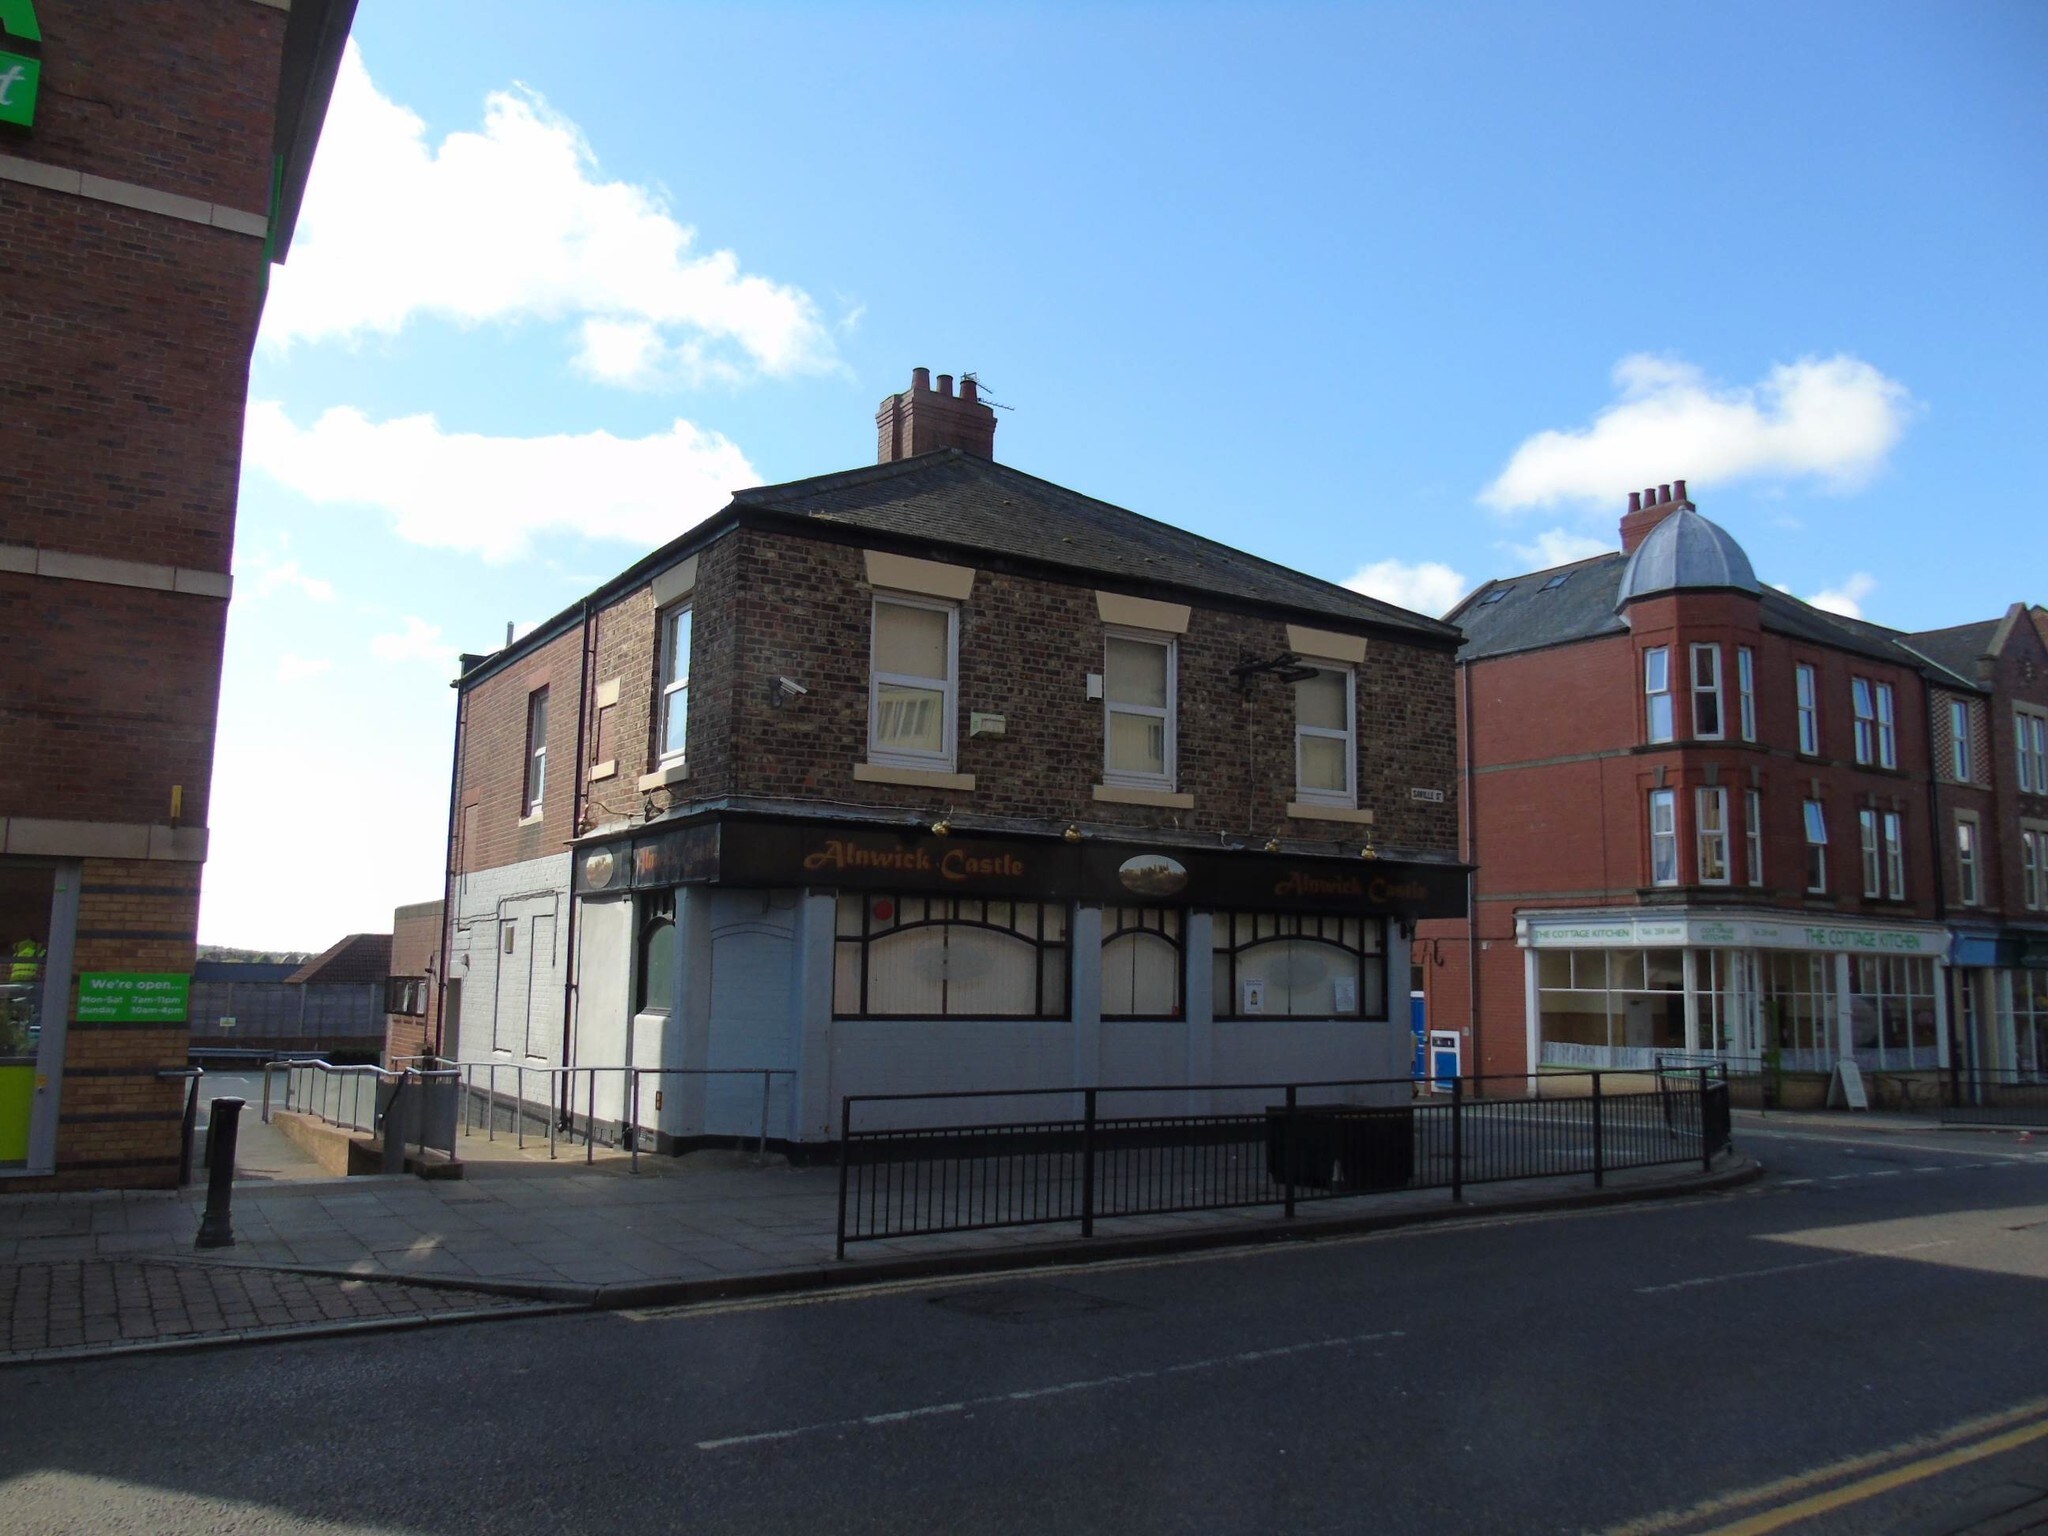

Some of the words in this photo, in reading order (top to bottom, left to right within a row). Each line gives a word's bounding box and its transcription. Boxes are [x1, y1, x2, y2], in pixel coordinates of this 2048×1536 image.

[803, 840, 931, 872] Alnwick
[940, 848, 1025, 883] Castle
[1535, 930, 1550, 940] THE
[1552, 929, 1590, 939] COTTAGE
[1592, 928, 1630, 937] KITCHEN
[1805, 927, 1825, 945] THE
[1829, 929, 1876, 947] COTTAGE
[1878, 931, 1920, 949] KITCHEN
[91, 979, 133, 990] We're
[79, 1006, 118, 1015] Sunday
